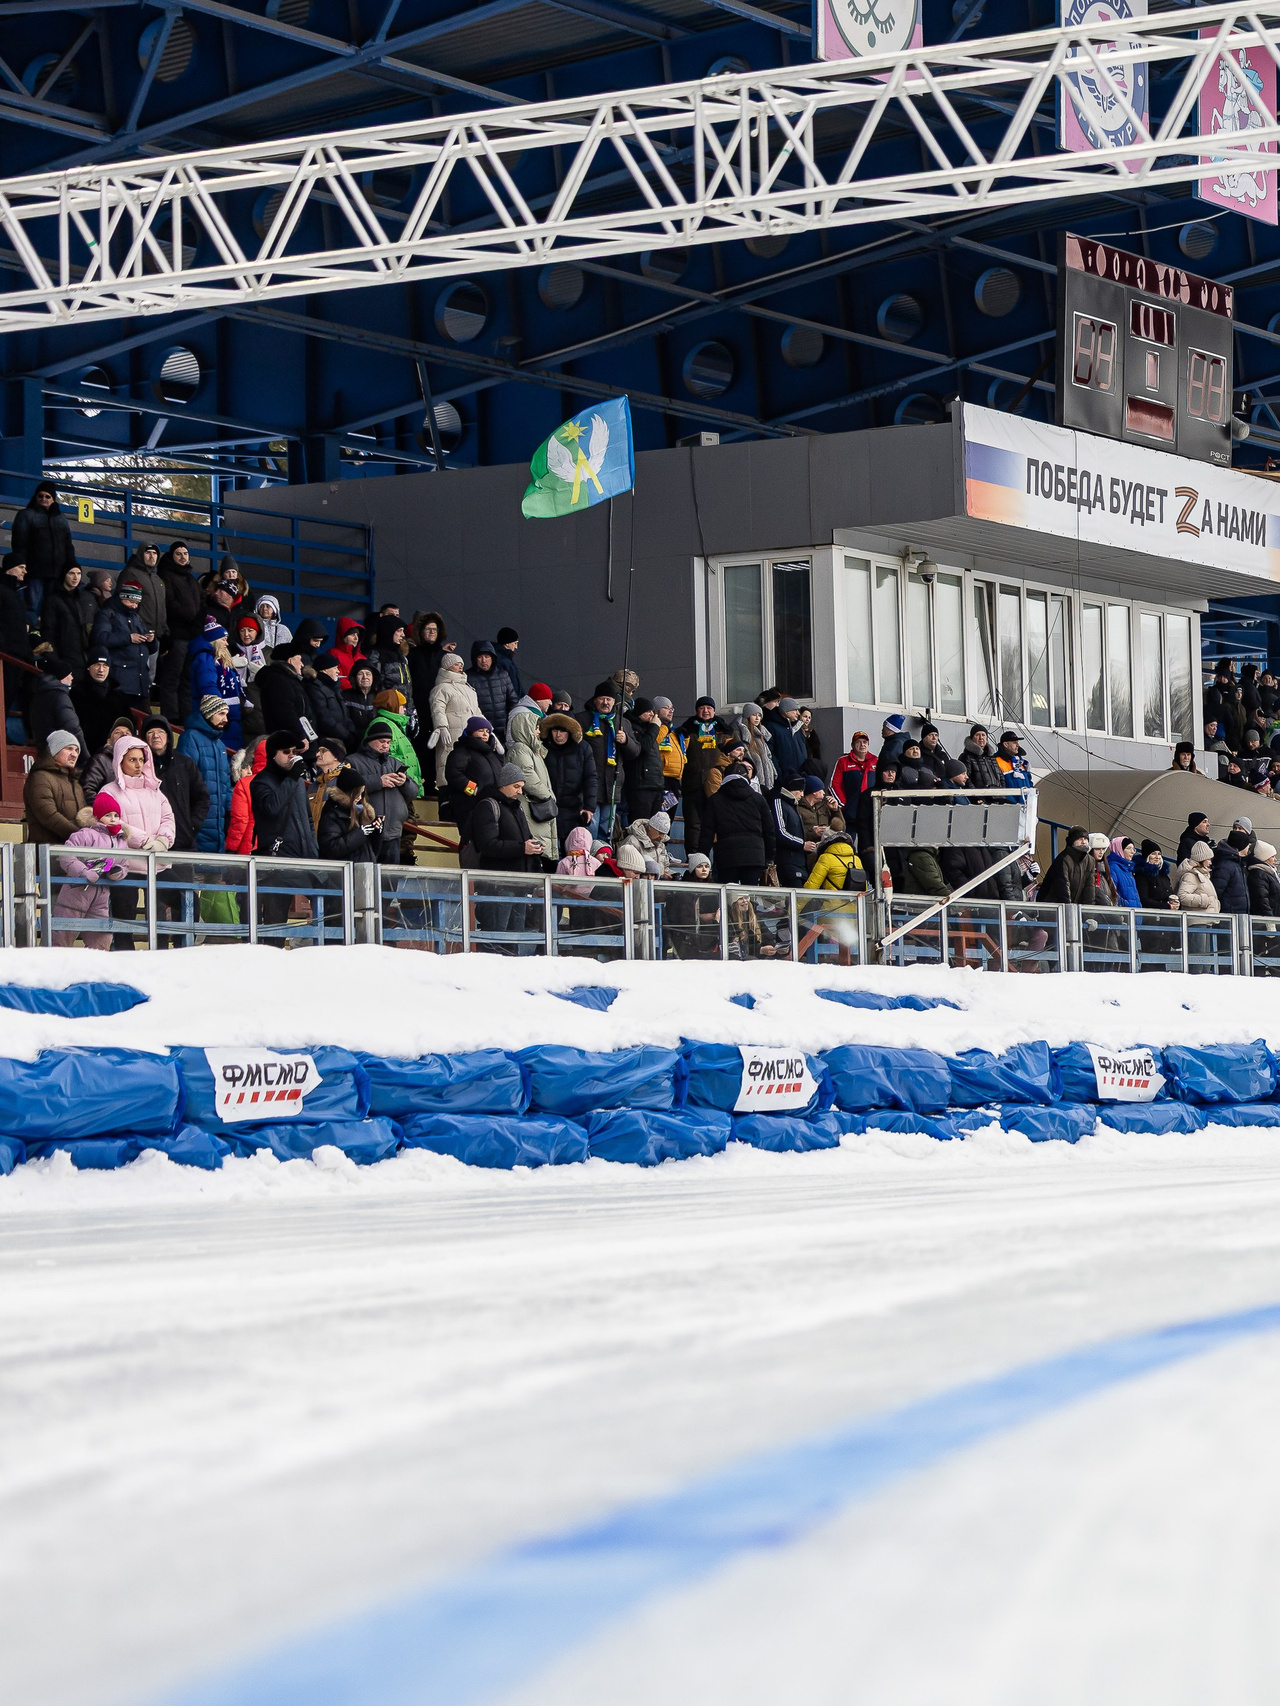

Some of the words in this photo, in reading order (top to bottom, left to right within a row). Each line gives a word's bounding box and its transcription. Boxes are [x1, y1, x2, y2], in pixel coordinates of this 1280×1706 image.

[83, 504, 89, 518] 3
[1026, 457, 1105, 515] ПОБЕДА
[1109, 477, 1168, 526] БУДЕТ
[1217, 503, 1267, 548] НАМИ
[222, 1061, 309, 1087] ФМСМО
[748, 1056, 803, 1081] ФМСМО
[1098, 1056, 1153, 1076] ФМСМО
